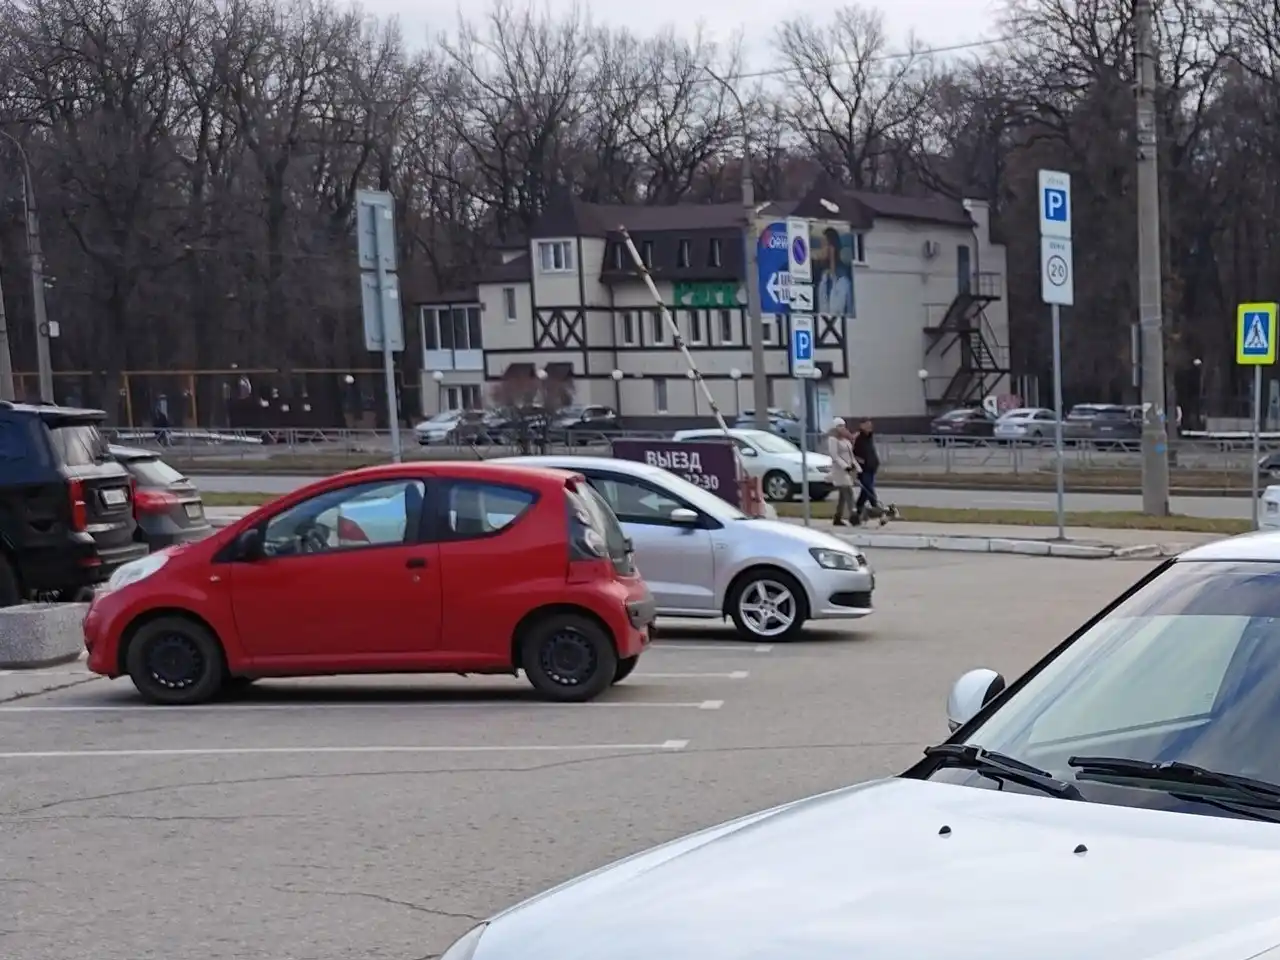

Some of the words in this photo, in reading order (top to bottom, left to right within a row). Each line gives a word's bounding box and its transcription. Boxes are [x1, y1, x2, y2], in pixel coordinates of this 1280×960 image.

[1048, 191, 1063, 217] P
[1050, 264, 1065, 278] 20
[799, 333, 809, 356] P
[646, 450, 702, 473] ВЫЕЗД
